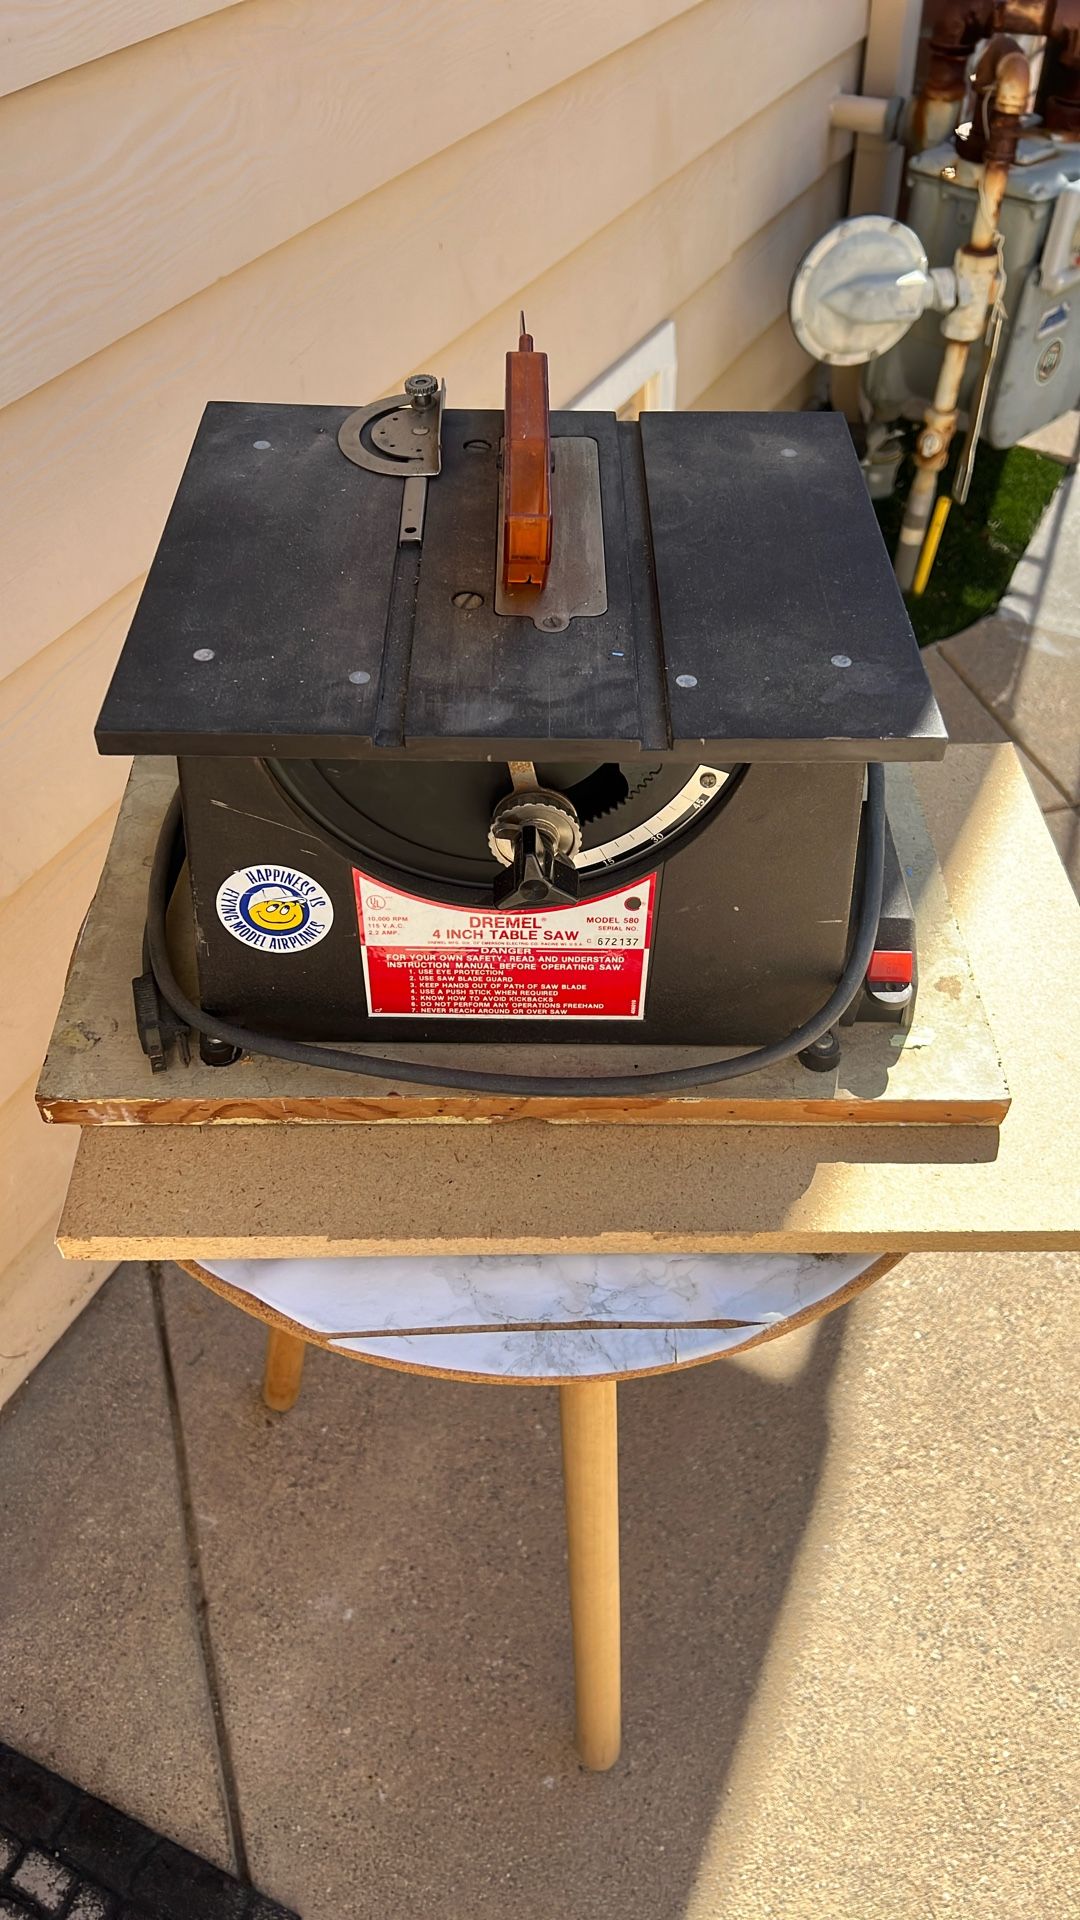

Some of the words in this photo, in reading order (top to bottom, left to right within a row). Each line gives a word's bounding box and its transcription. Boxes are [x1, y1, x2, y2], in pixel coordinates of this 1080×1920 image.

[692, 799, 705, 809] 45
[650, 833, 664, 843] 30
[603, 858, 615, 867] 15
[245, 868, 316, 896] HAPPINESS
[309, 896, 326, 908] IS
[221, 888, 240, 921] FLYING
[469, 916, 542, 929] DREMEL
[230, 920, 267, 947] MODEL
[269, 920, 325, 950] AIRPLANES
[432, 929, 440, 939] 4
[446, 929, 483, 939] INCH
[489, 930, 538, 940] TABLE
[543, 930, 579, 941] SAW
[597, 938, 639, 946] 672137
[480, 947, 532, 955] DANGER
[386, 953, 406, 961] FOR
[541, 963, 595, 971] OPERATING
